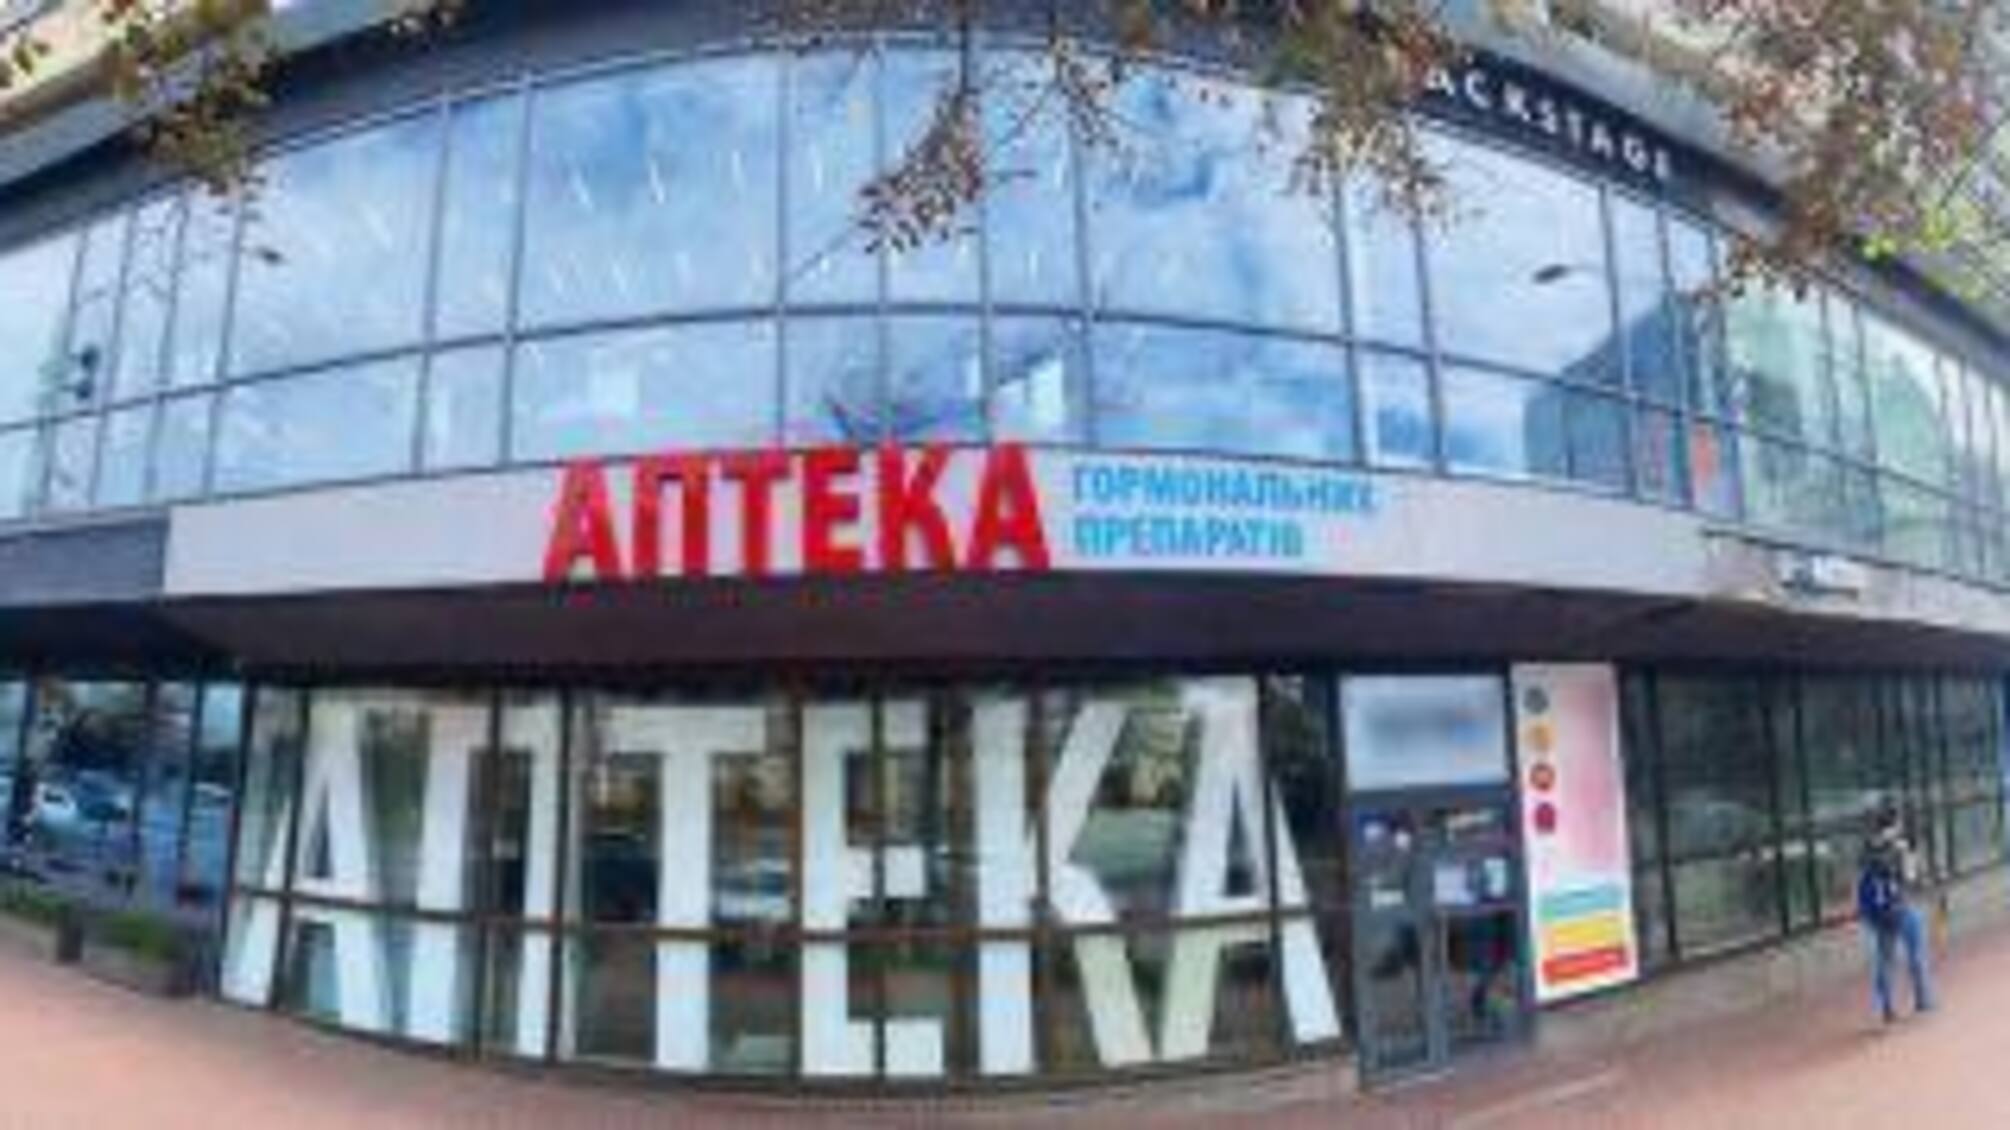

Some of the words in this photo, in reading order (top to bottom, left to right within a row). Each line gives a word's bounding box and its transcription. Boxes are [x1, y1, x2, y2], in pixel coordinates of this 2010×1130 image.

[1422, 66, 1672, 180] ACKSTAGE
[542, 440, 1051, 583] АПТЕКА
[1073, 515, 1302, 556] ПРЕПАРАТІВ
[221, 676, 1341, 1077] АПТЕКА
